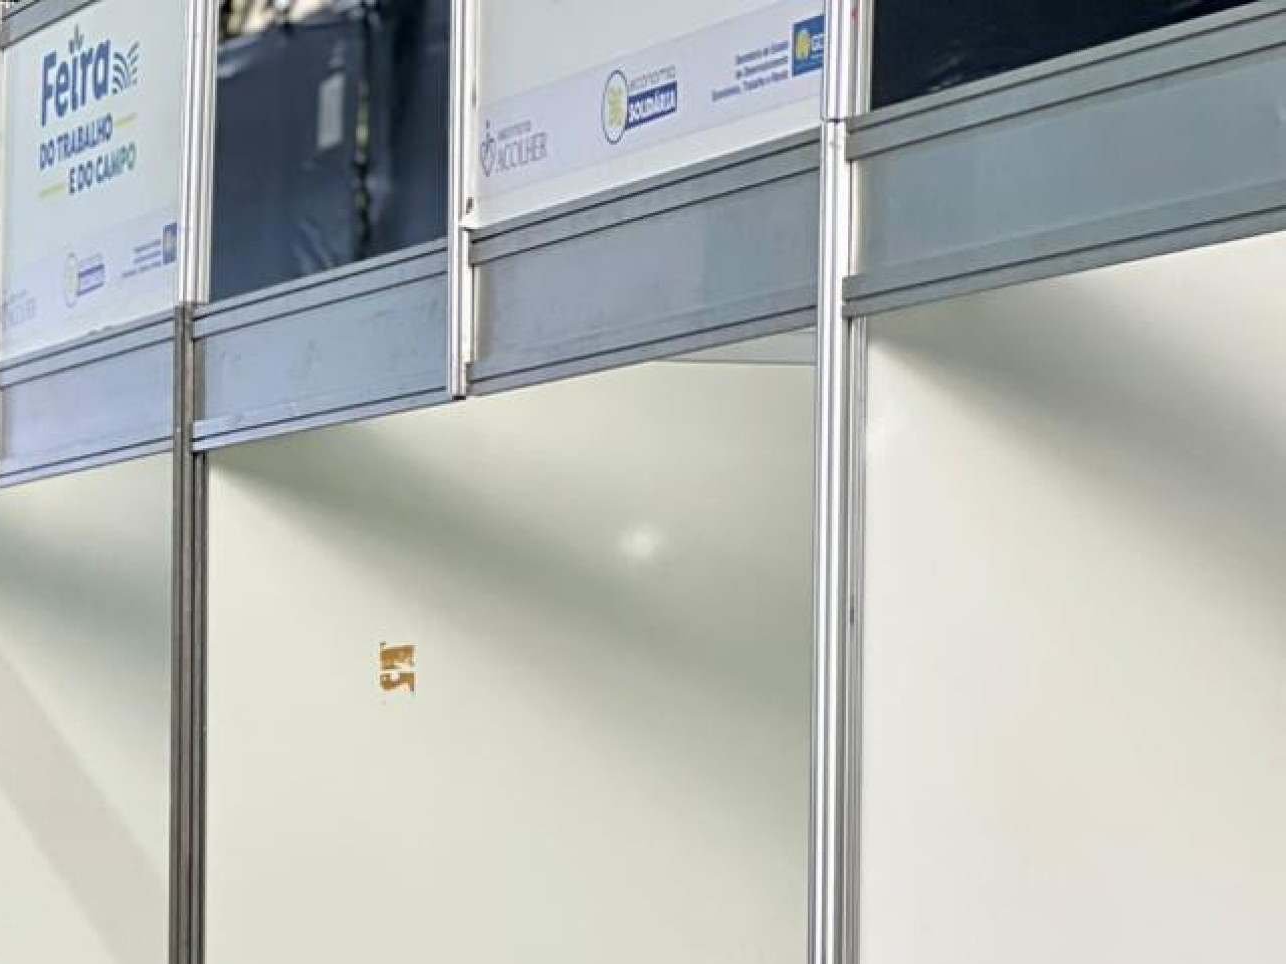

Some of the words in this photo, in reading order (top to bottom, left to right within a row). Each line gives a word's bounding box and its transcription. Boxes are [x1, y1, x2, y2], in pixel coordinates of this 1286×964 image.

[42, 36, 111, 127] Feira
[40, 139, 54, 169] DO
[57, 112, 112, 160] TRABALHO
[69, 167, 75, 194] E
[78, 160, 92, 191] DO
[96, 142, 135, 183] CAMPO
